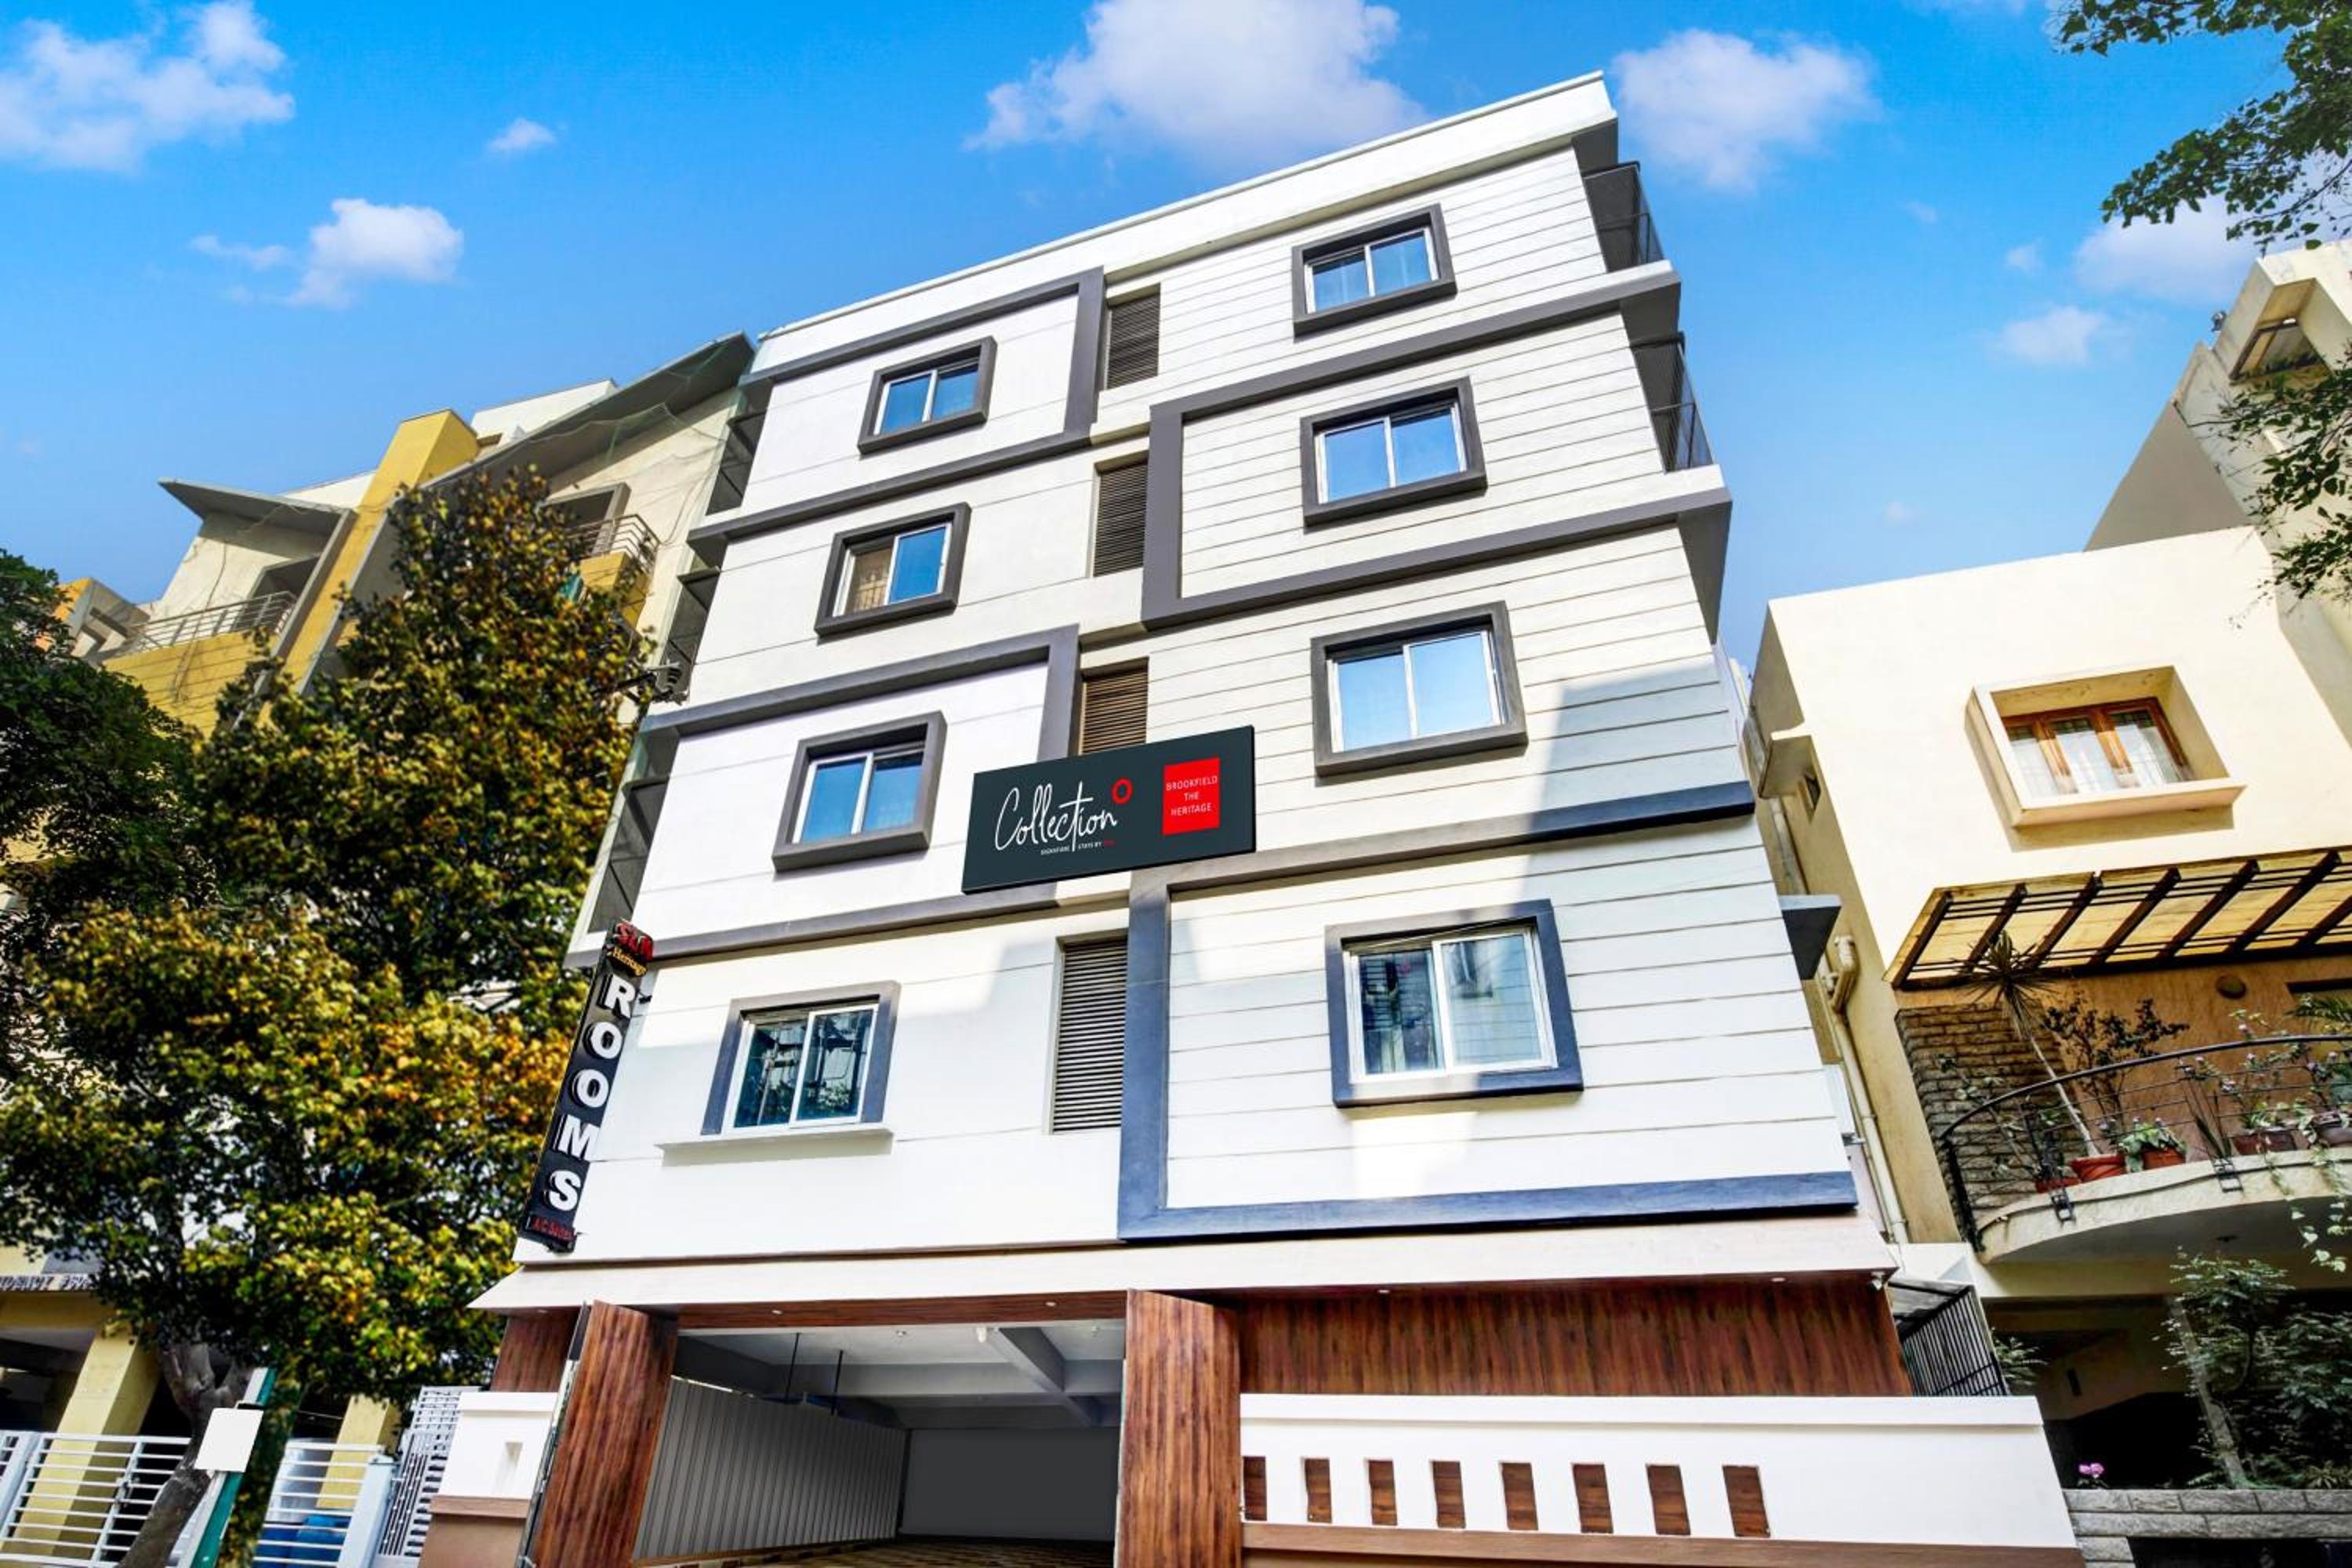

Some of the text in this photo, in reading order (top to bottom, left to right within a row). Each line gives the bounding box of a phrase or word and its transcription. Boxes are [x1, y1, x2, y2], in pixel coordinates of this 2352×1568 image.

[1166, 775, 1218, 791] BROOKFIELD
[1184, 791, 1200, 801] THE
[995, 782, 1117, 851] Collection
[1171, 802, 1212, 816] HERITAGE
[547, 973, 637, 1212] ROOMS
